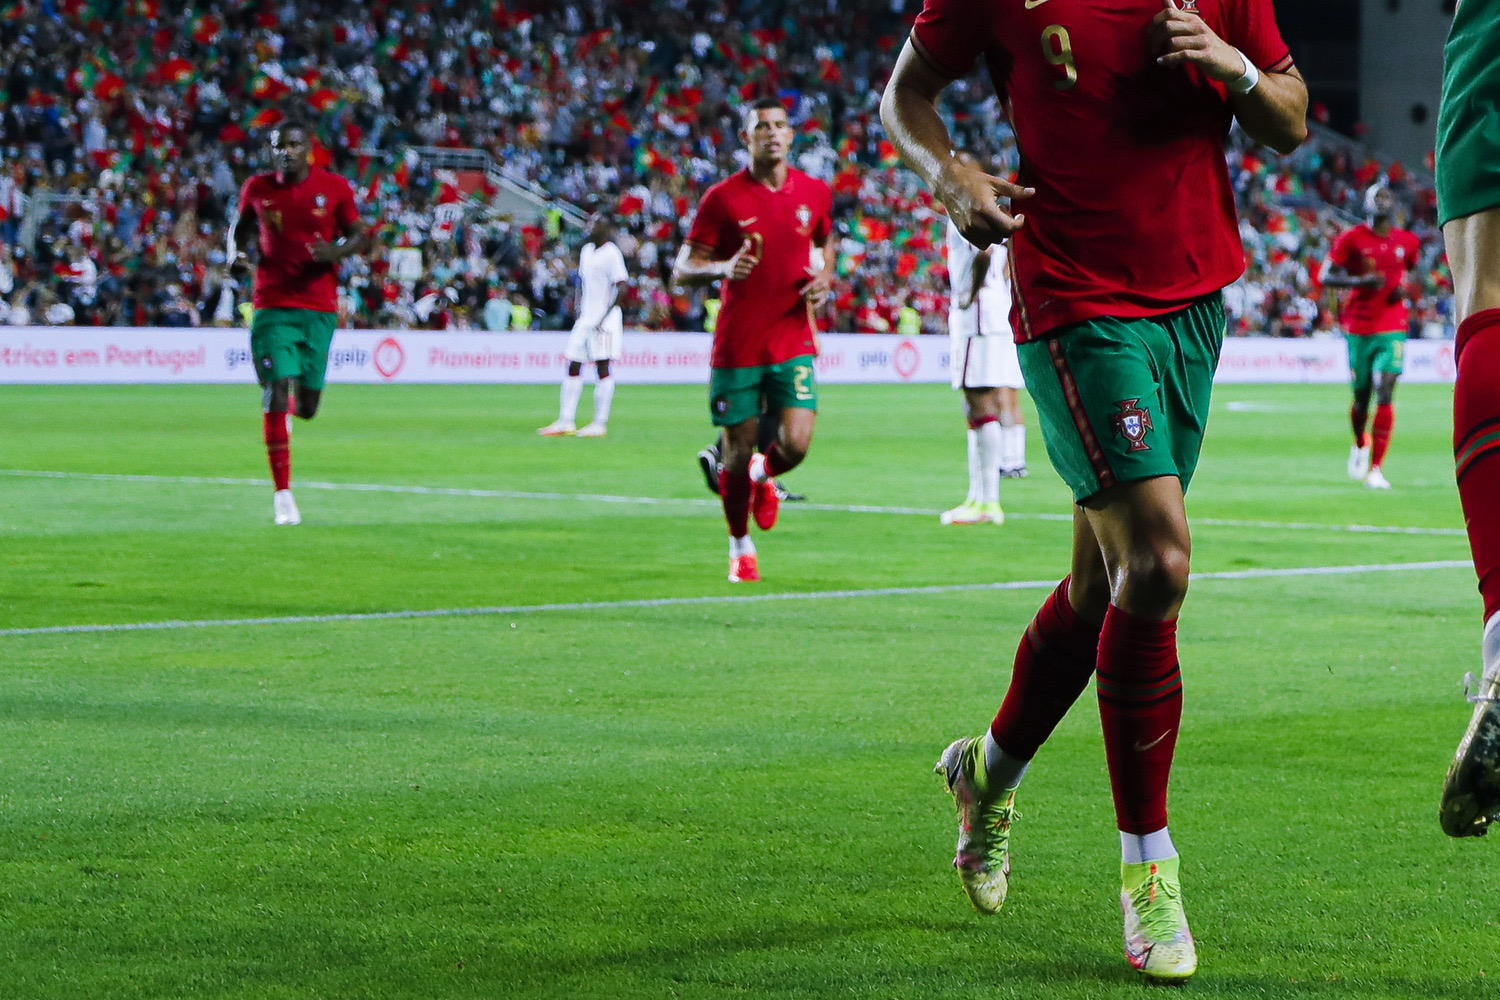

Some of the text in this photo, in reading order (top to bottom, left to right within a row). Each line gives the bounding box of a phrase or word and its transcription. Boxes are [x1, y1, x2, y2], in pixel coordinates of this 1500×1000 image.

[1041, 24, 1078, 90] 9
[106, 345, 205, 373] Portugal
[794, 365, 814, 400] 2
